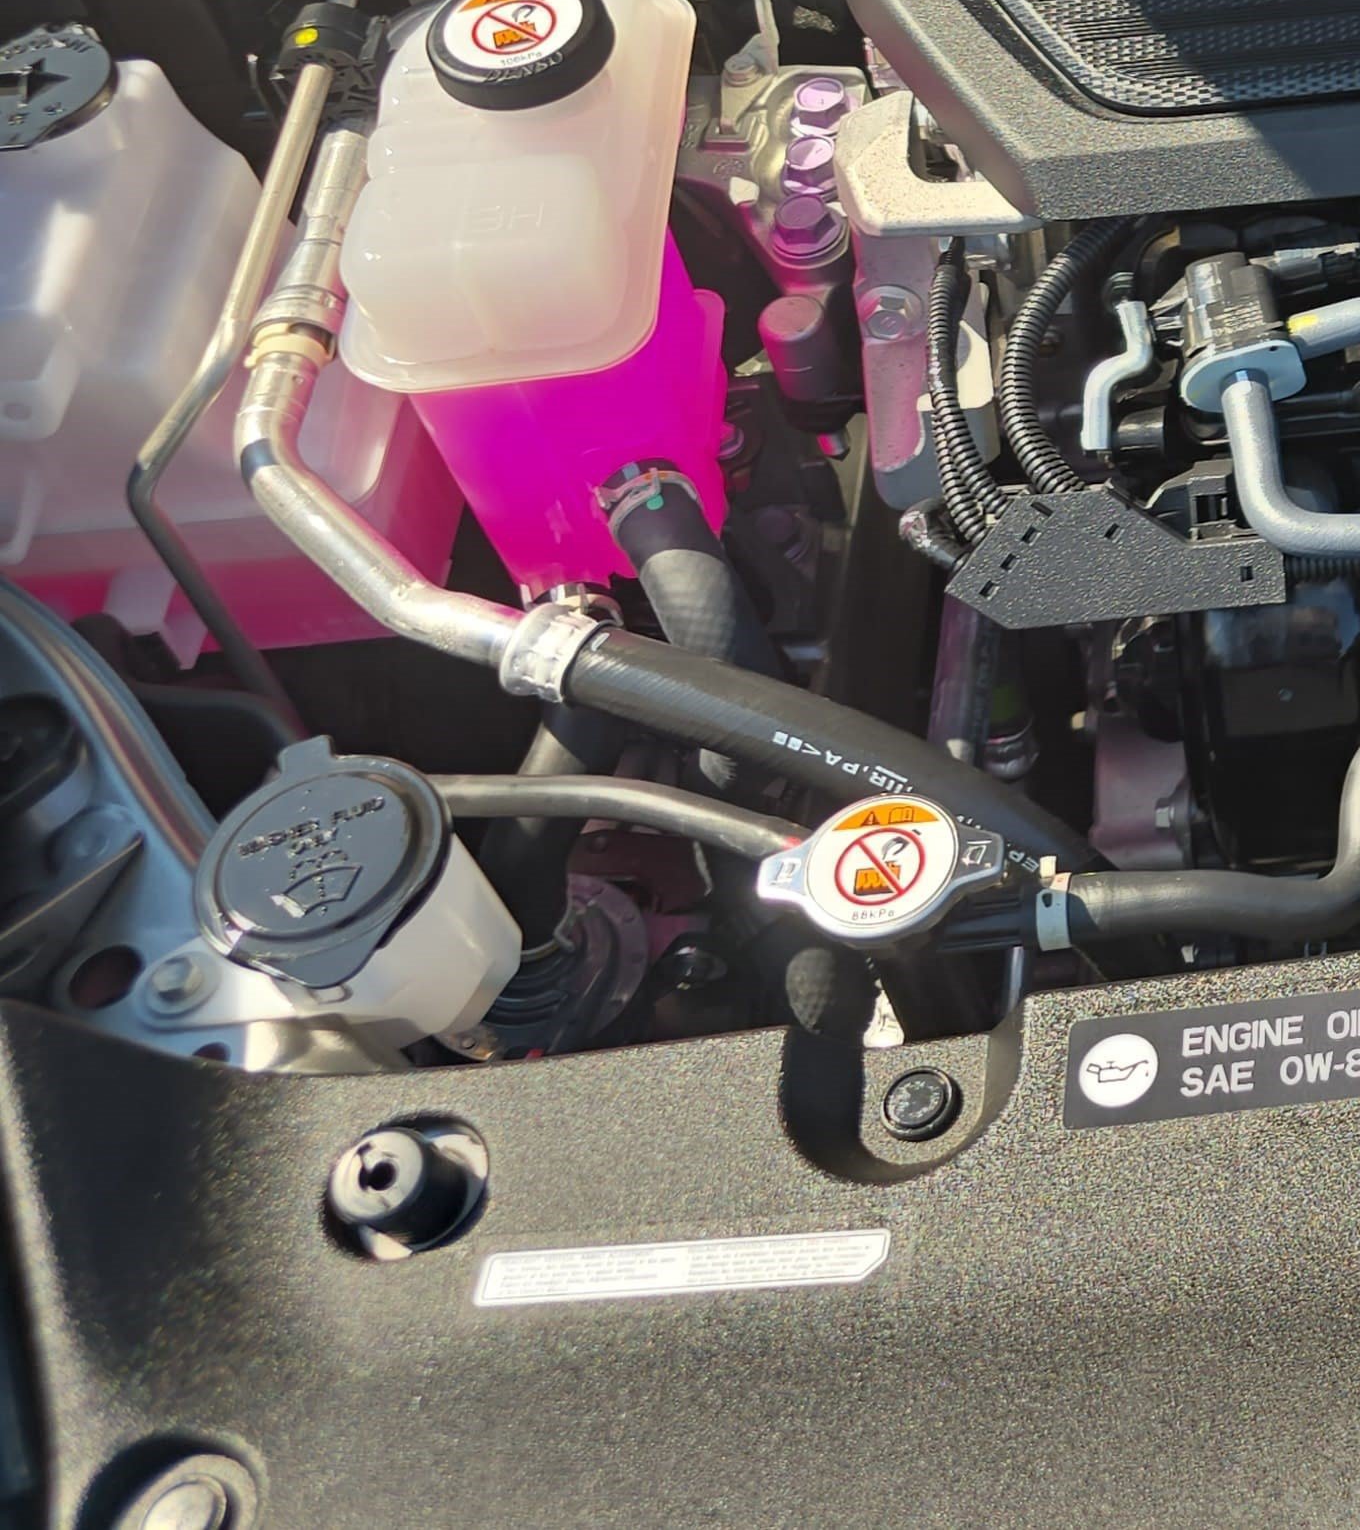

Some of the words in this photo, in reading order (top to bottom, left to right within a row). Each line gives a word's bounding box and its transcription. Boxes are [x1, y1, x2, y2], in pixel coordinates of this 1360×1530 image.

[483, 51, 564, 83] DENSO
[1182, 1015, 1304, 1057] ENGINE
[1180, 1060, 1256, 1098] SAE
